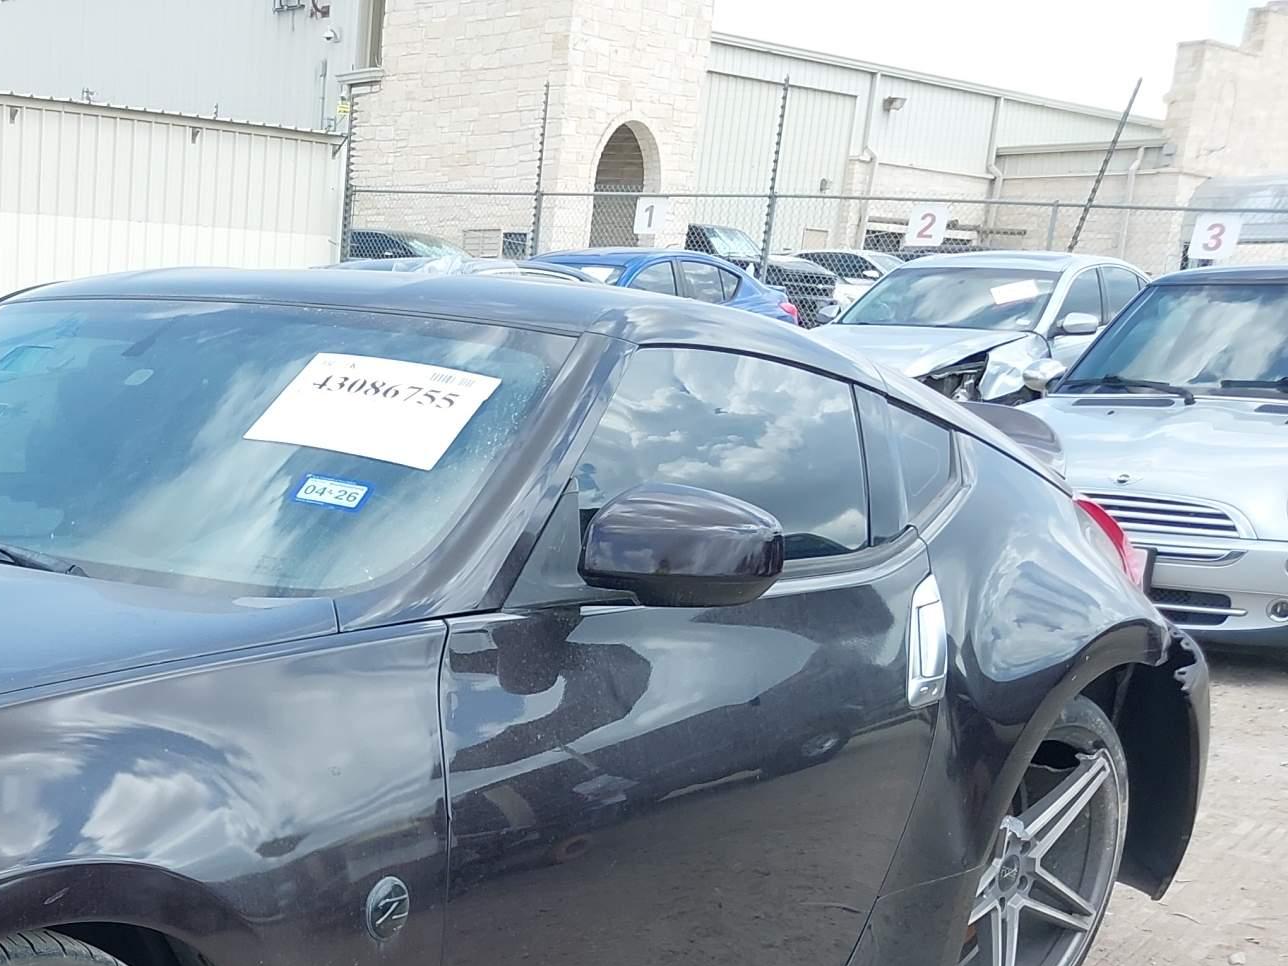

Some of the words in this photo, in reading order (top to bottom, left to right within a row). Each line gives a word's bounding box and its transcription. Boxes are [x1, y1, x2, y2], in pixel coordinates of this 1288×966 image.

[644, 204, 655, 228] 1
[915, 212, 937, 239] 2
[1202, 223, 1226, 252] 3
[312, 374, 461, 409] 43086755
